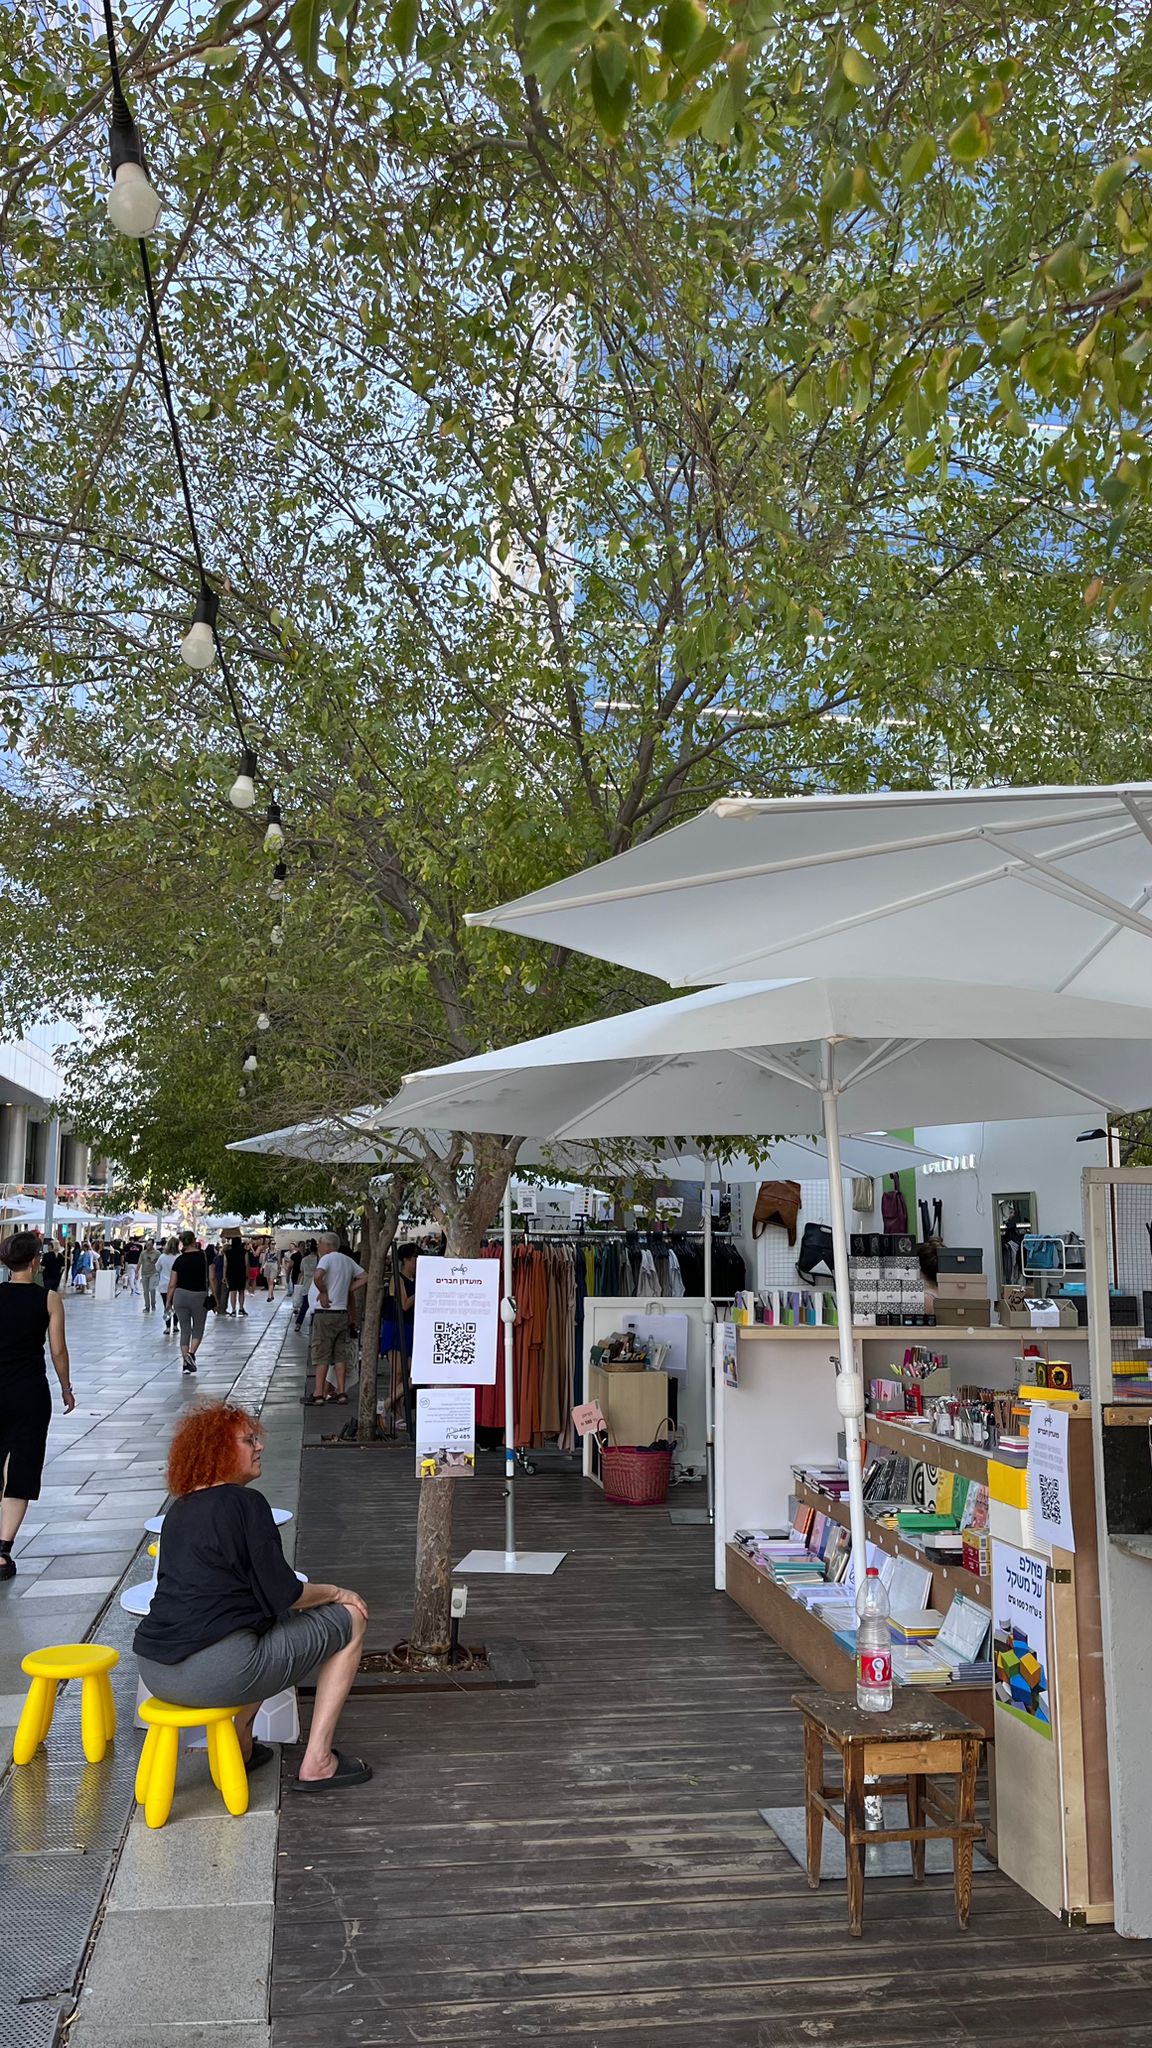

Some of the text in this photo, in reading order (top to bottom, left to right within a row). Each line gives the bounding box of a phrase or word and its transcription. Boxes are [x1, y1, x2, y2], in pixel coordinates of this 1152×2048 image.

[1006, 1566, 1030, 1592] משקל
[1020, 1556, 1043, 1579] פאלפ
[1031, 1578, 1043, 1599] על
